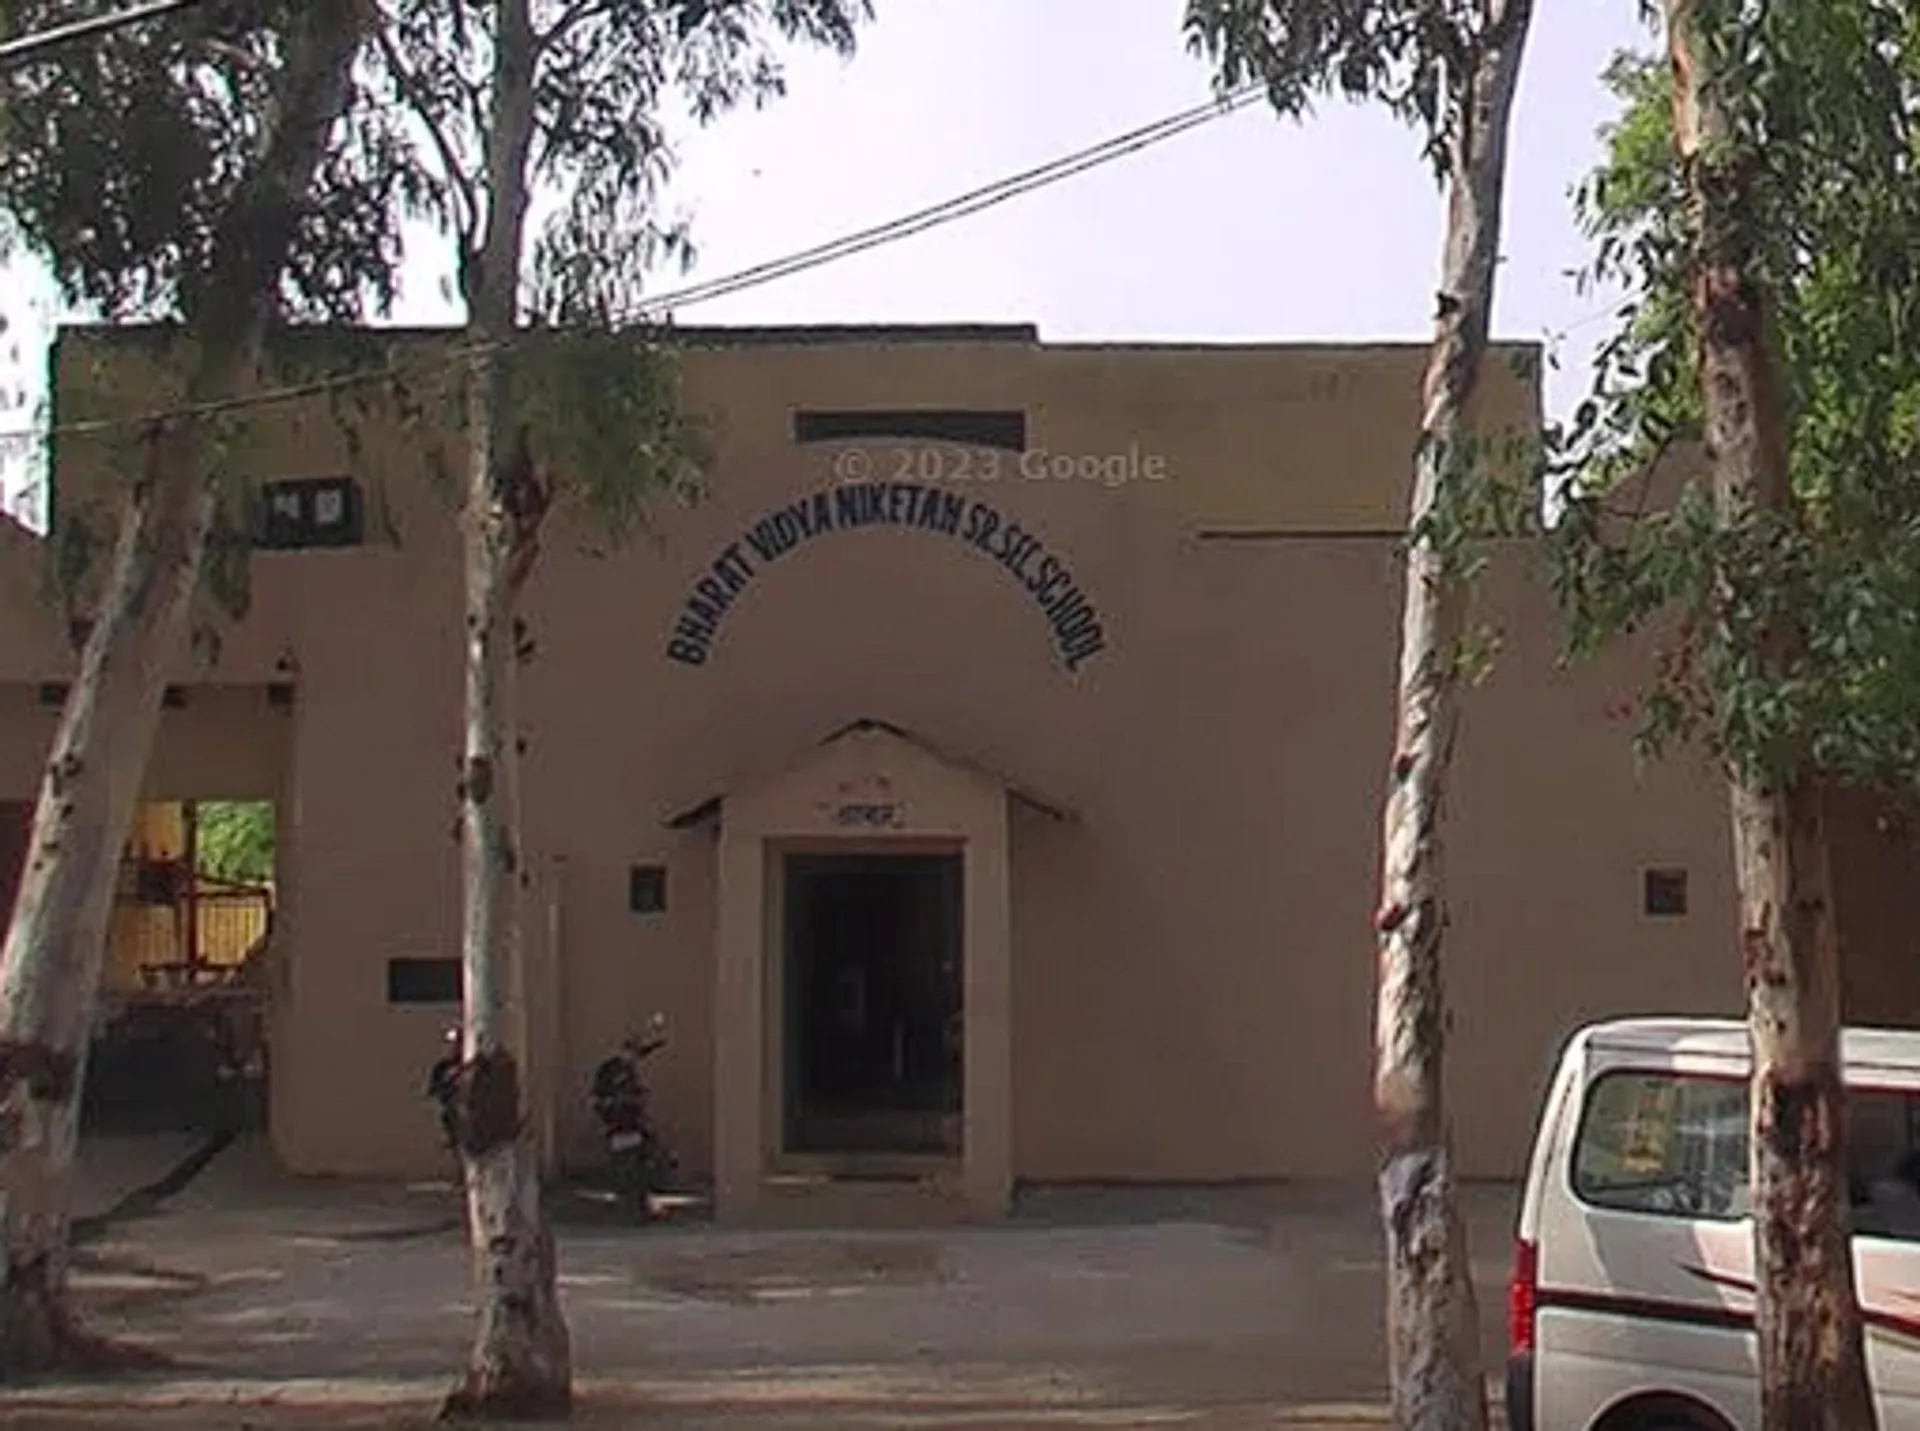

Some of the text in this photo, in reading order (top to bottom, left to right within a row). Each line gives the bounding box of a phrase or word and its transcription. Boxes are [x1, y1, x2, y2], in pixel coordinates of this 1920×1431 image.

[667, 542, 754, 665] BHARAT
[745, 496, 834, 562] VIDYA
[836, 482, 965, 536] NIKETAN
[1027, 557, 1105, 673] SCHOOL
